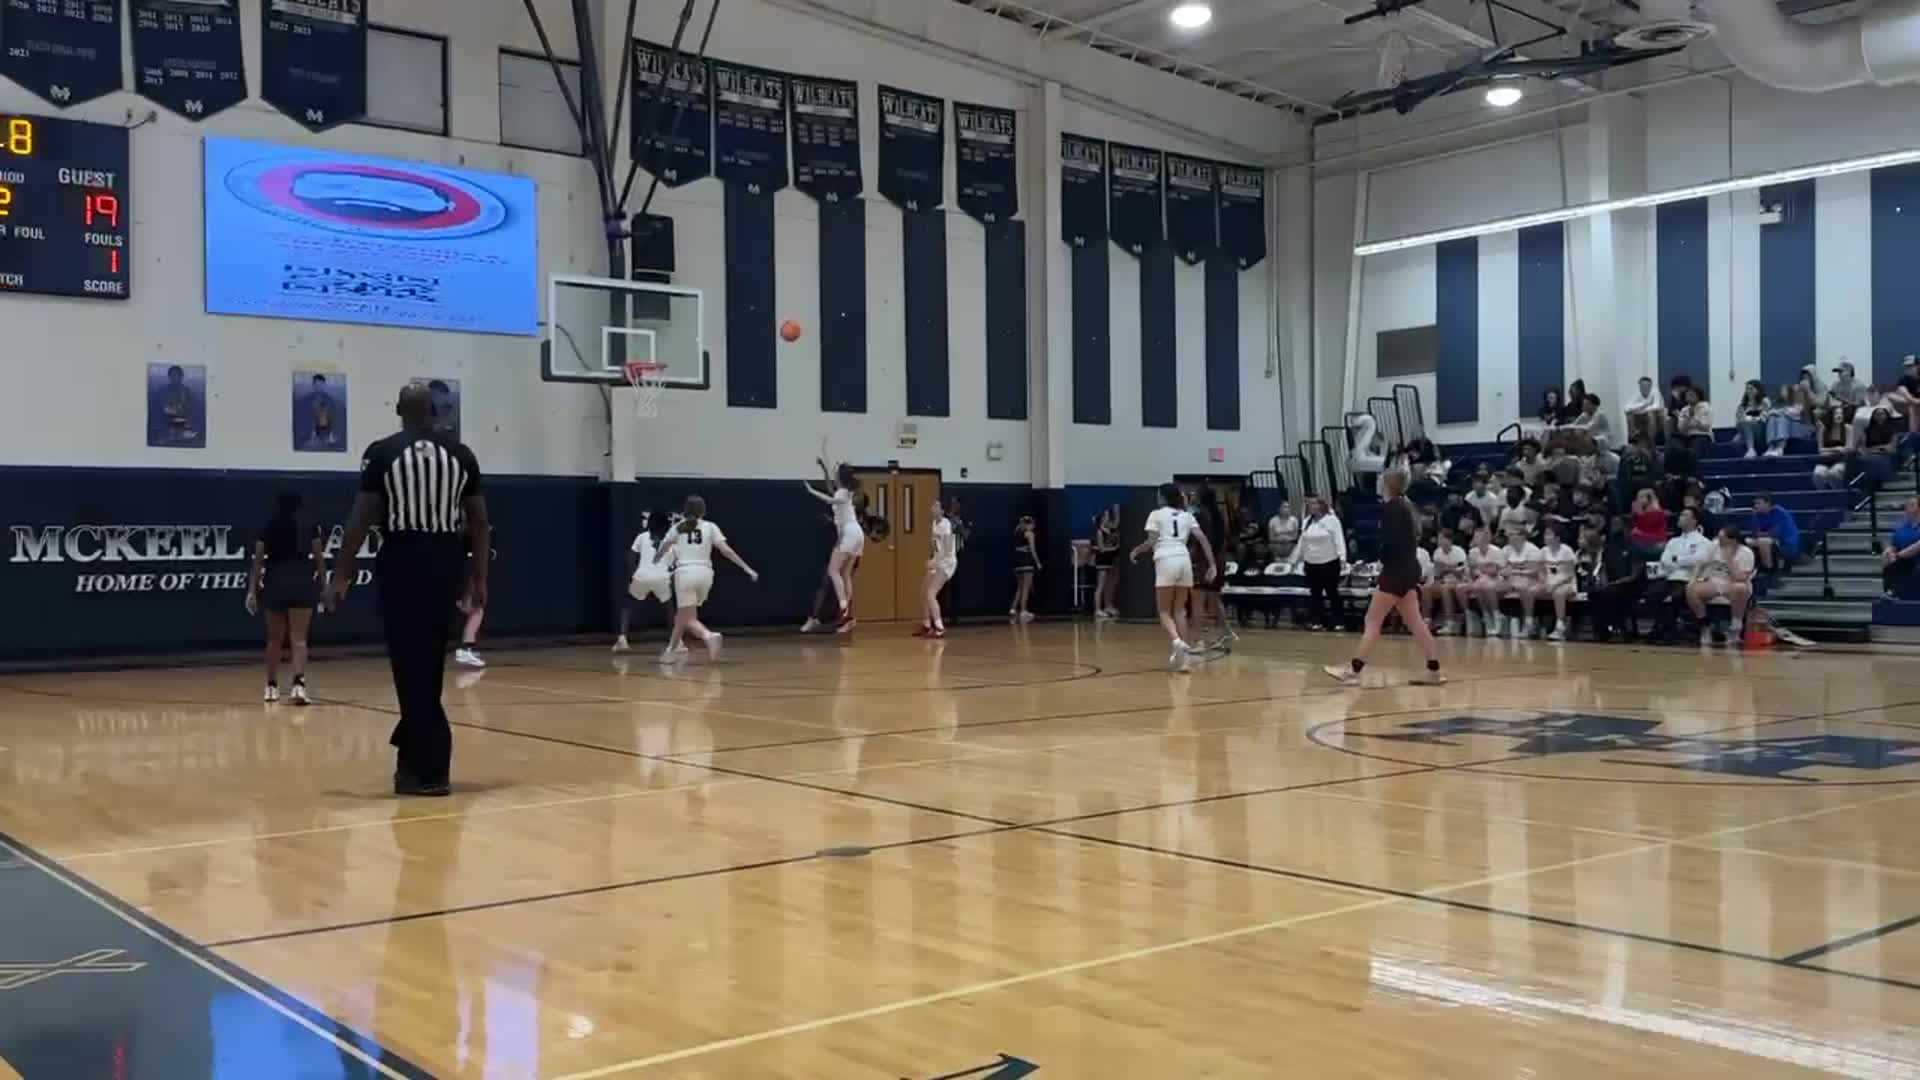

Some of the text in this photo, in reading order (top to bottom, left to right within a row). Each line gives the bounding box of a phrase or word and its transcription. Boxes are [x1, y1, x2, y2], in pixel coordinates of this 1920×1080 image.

[58, 167, 115, 188] GUEST
[86, 195, 118, 227] 19
[14, 225, 46, 240] FOUL
[84, 232, 123, 247] FOULS
[112, 250, 119, 273] 1
[83, 279, 123, 294] SCORE
[1172, 519, 1179, 538] 1
[9, 524, 246, 563] MCKEEL
[75, 572, 157, 592] HOME
[159, 573, 196, 591] OF
[198, 571, 248, 590] THE
